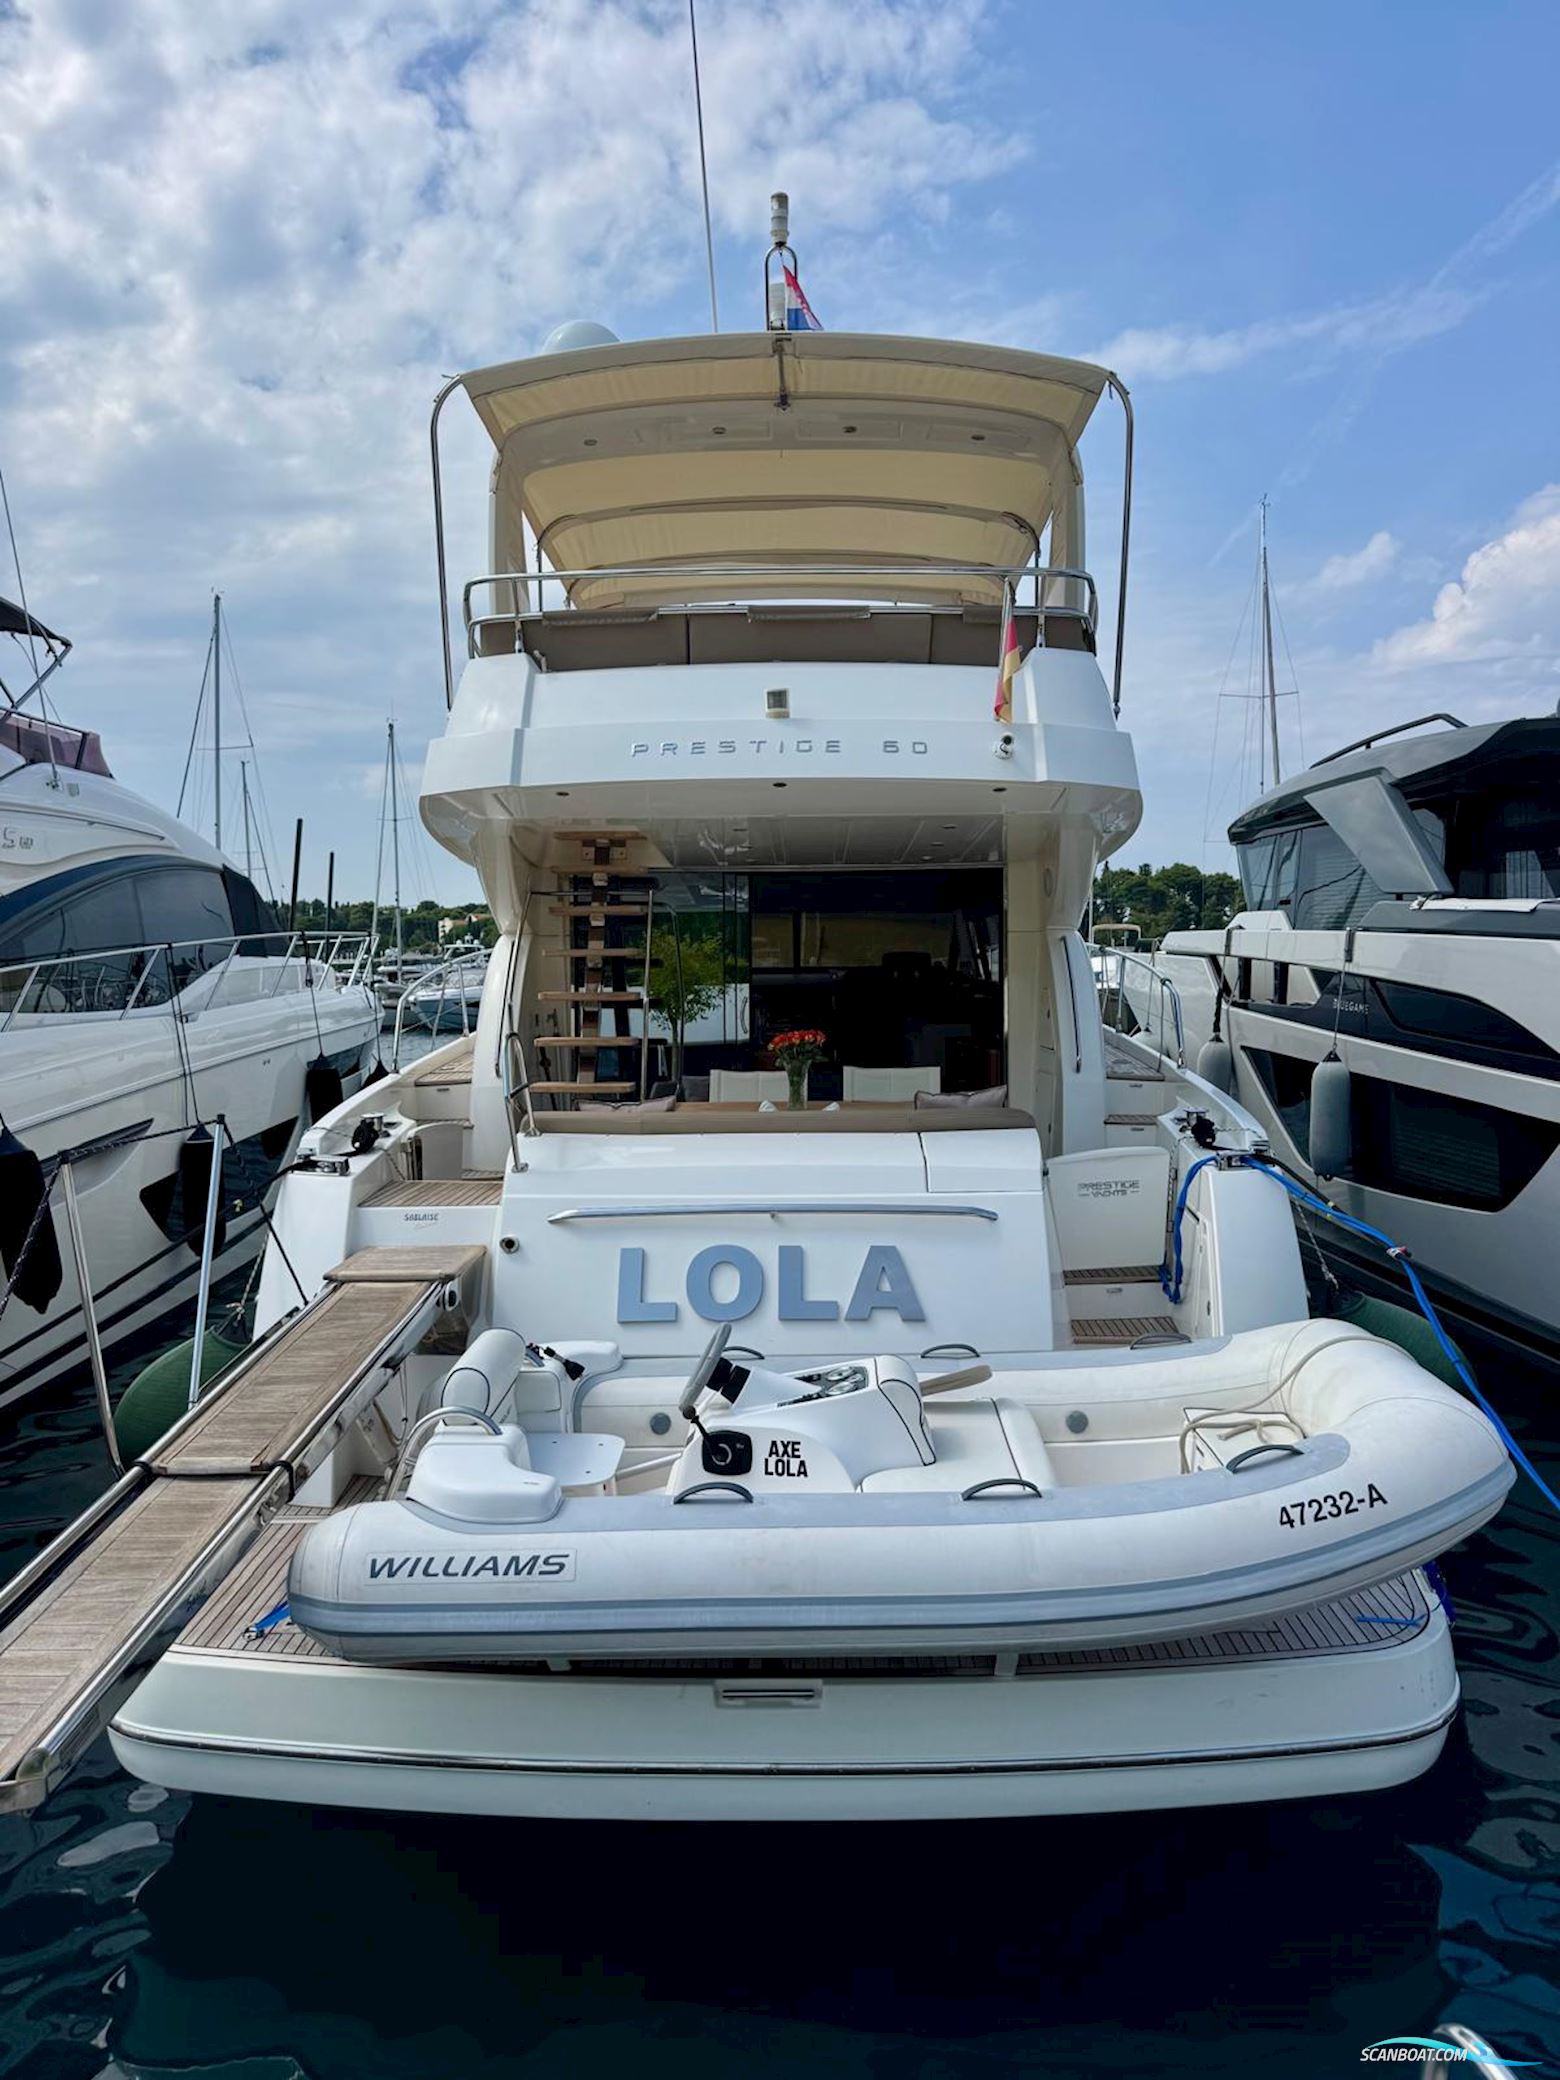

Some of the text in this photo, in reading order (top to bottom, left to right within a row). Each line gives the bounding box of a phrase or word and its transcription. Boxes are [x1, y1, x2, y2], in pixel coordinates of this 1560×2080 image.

[632, 740, 928, 757] PRESTIGE 60
[1332, 998, 1369, 1015] BUEGAME
[1078, 1180, 1140, 1191] PRESTIGE
[617, 1244, 926, 1323] LOLA
[768, 1440, 801, 1459] AXE
[764, 1457, 808, 1477] LOLA
[1279, 1483, 1388, 1528] 47232-A
[369, 1554, 570, 1579] WILLIAMS
